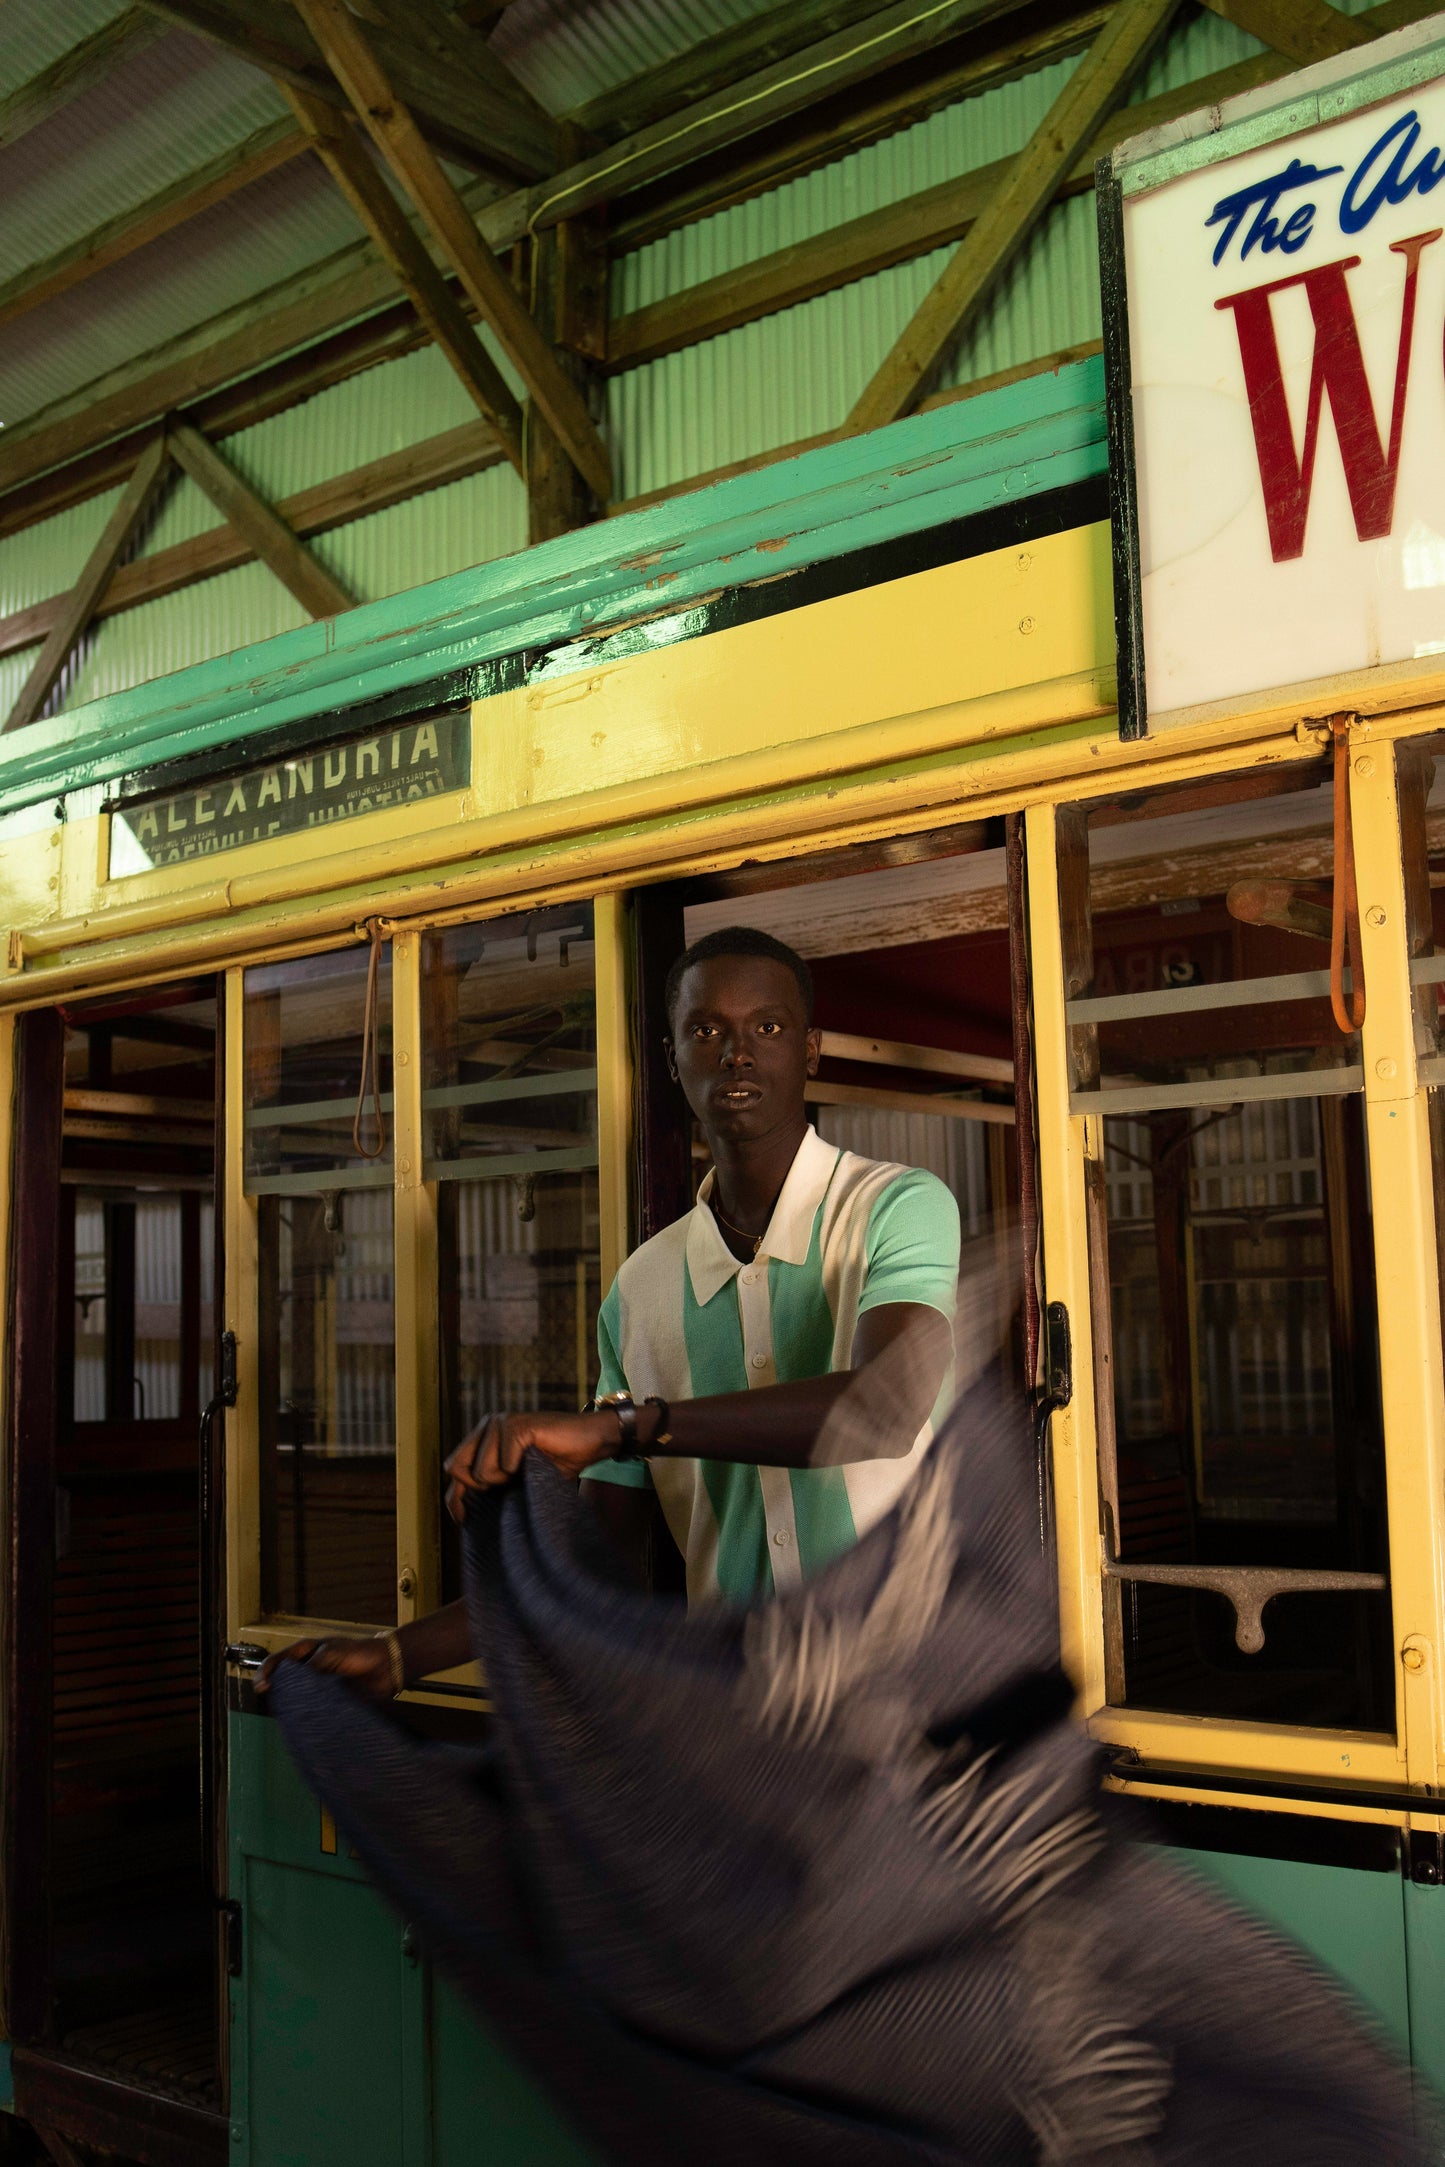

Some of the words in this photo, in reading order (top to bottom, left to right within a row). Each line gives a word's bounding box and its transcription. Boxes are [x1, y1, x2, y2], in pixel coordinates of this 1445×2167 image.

[1204, 157, 1345, 267] The
[1213, 227, 1445, 564] W
[137, 719, 439, 842] ALEXANDRIA
